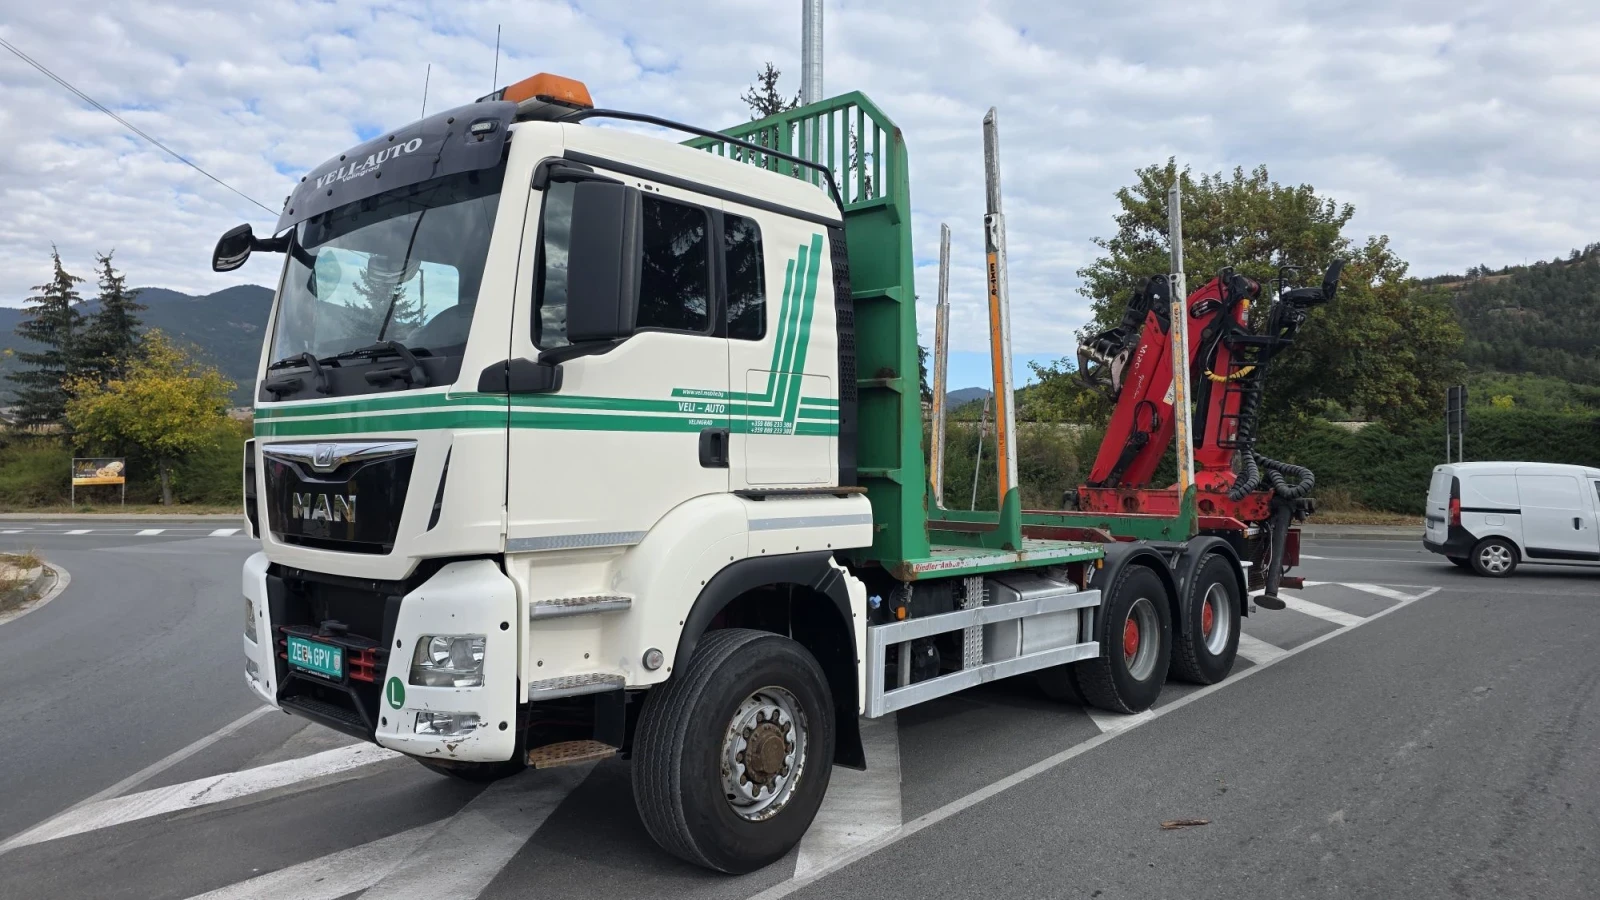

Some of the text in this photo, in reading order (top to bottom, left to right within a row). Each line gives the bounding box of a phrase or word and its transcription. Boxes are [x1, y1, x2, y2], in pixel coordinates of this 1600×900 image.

[316, 137, 423, 190] VELI-AUTO
[678, 402, 696, 412] VELI
[704, 403, 725, 414] AUTO
[292, 492, 357, 523] MAN
[391, 681, 401, 706] L
